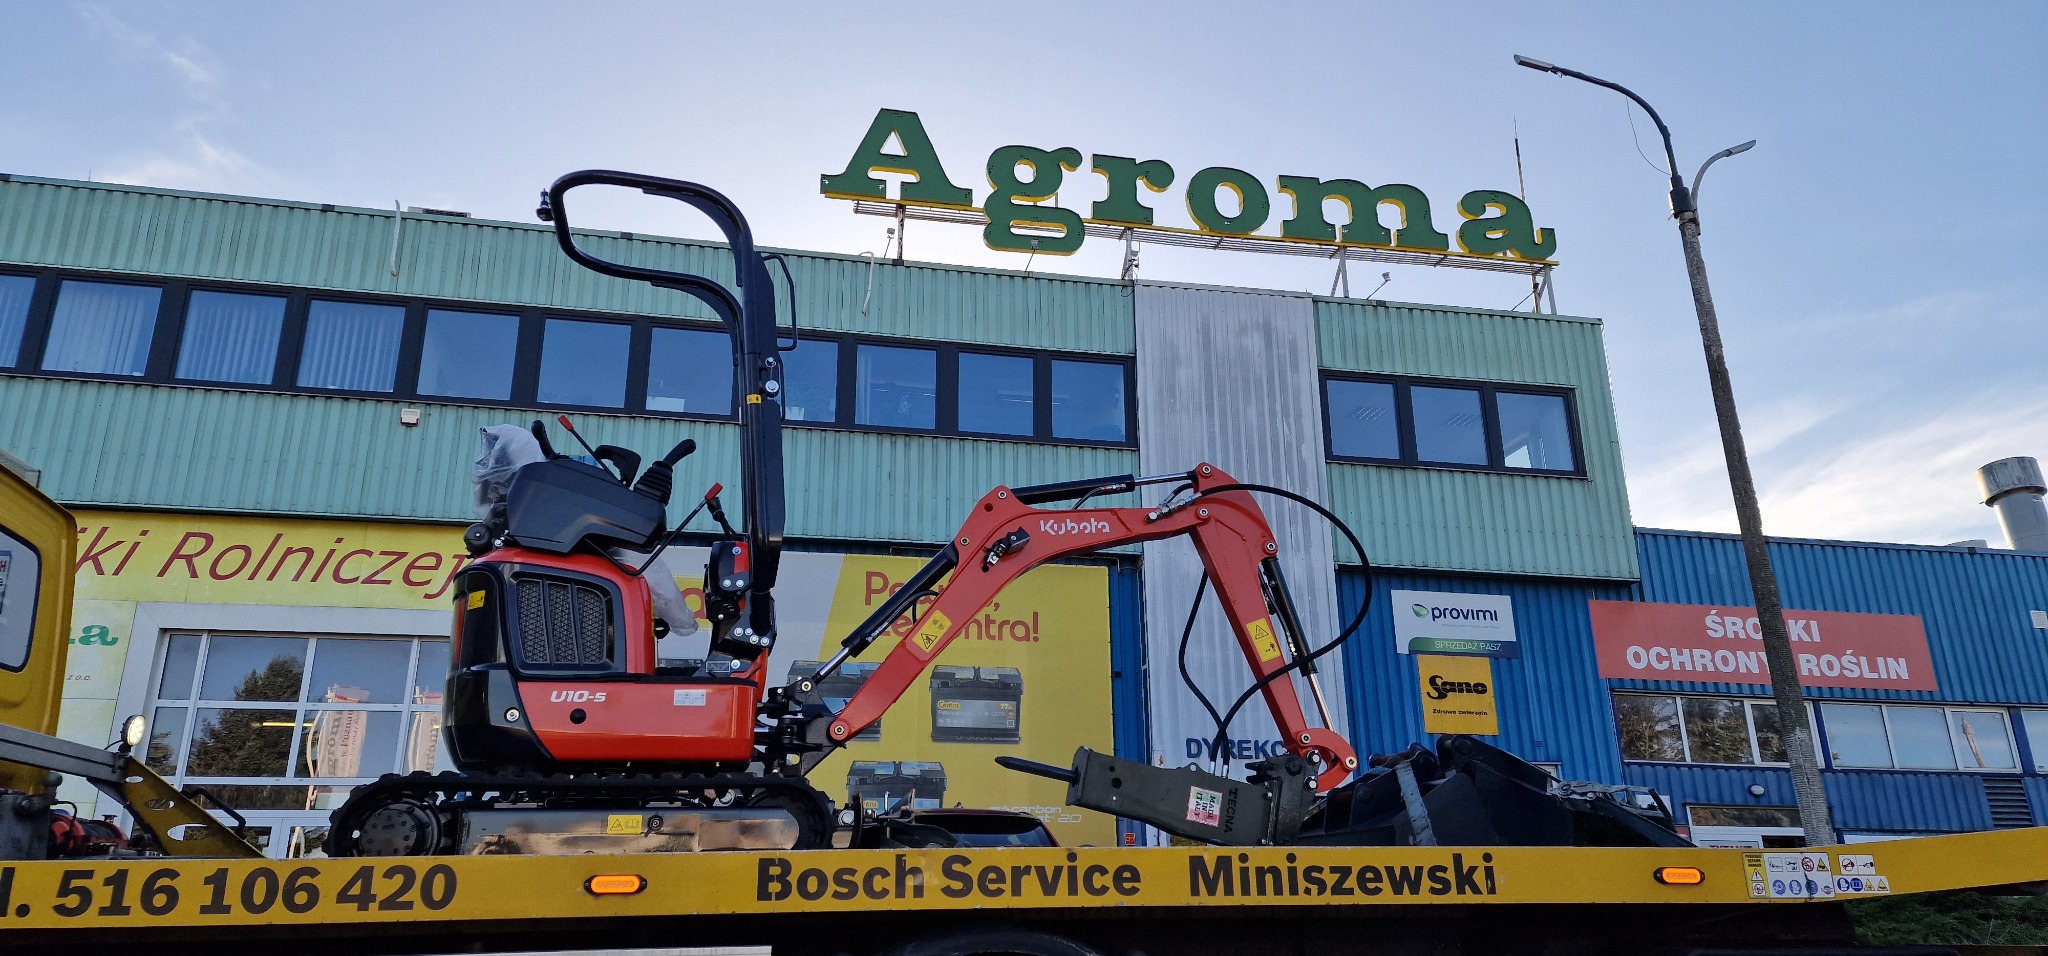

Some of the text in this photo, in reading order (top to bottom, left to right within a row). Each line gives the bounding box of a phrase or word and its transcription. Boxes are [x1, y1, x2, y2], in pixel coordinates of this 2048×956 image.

[820, 107, 1558, 259] Agroma
[1039, 517, 1110, 536] Kubota
[156, 531, 464, 600] Rolniczej
[1430, 606, 1499, 622] provimi
[1704, 609, 1821, 643] ŚROKI
[1798, 650, 1910, 680] ROŚLIN
[550, 690, 607, 703] U10-5
[1426, 674, 1488, 700] Sano
[1194, 791, 1203, 818] ITALY
[1201, 801, 1209, 813] IN
[1206, 794, 1216, 821] MADE
[1223, 787, 1239, 834] TECNA
[52, 868, 180, 918] 516
[199, 867, 321, 914] 106
[335, 864, 458, 912] 420
[756, 852, 1497, 902] Bosch Service Miniszewski
